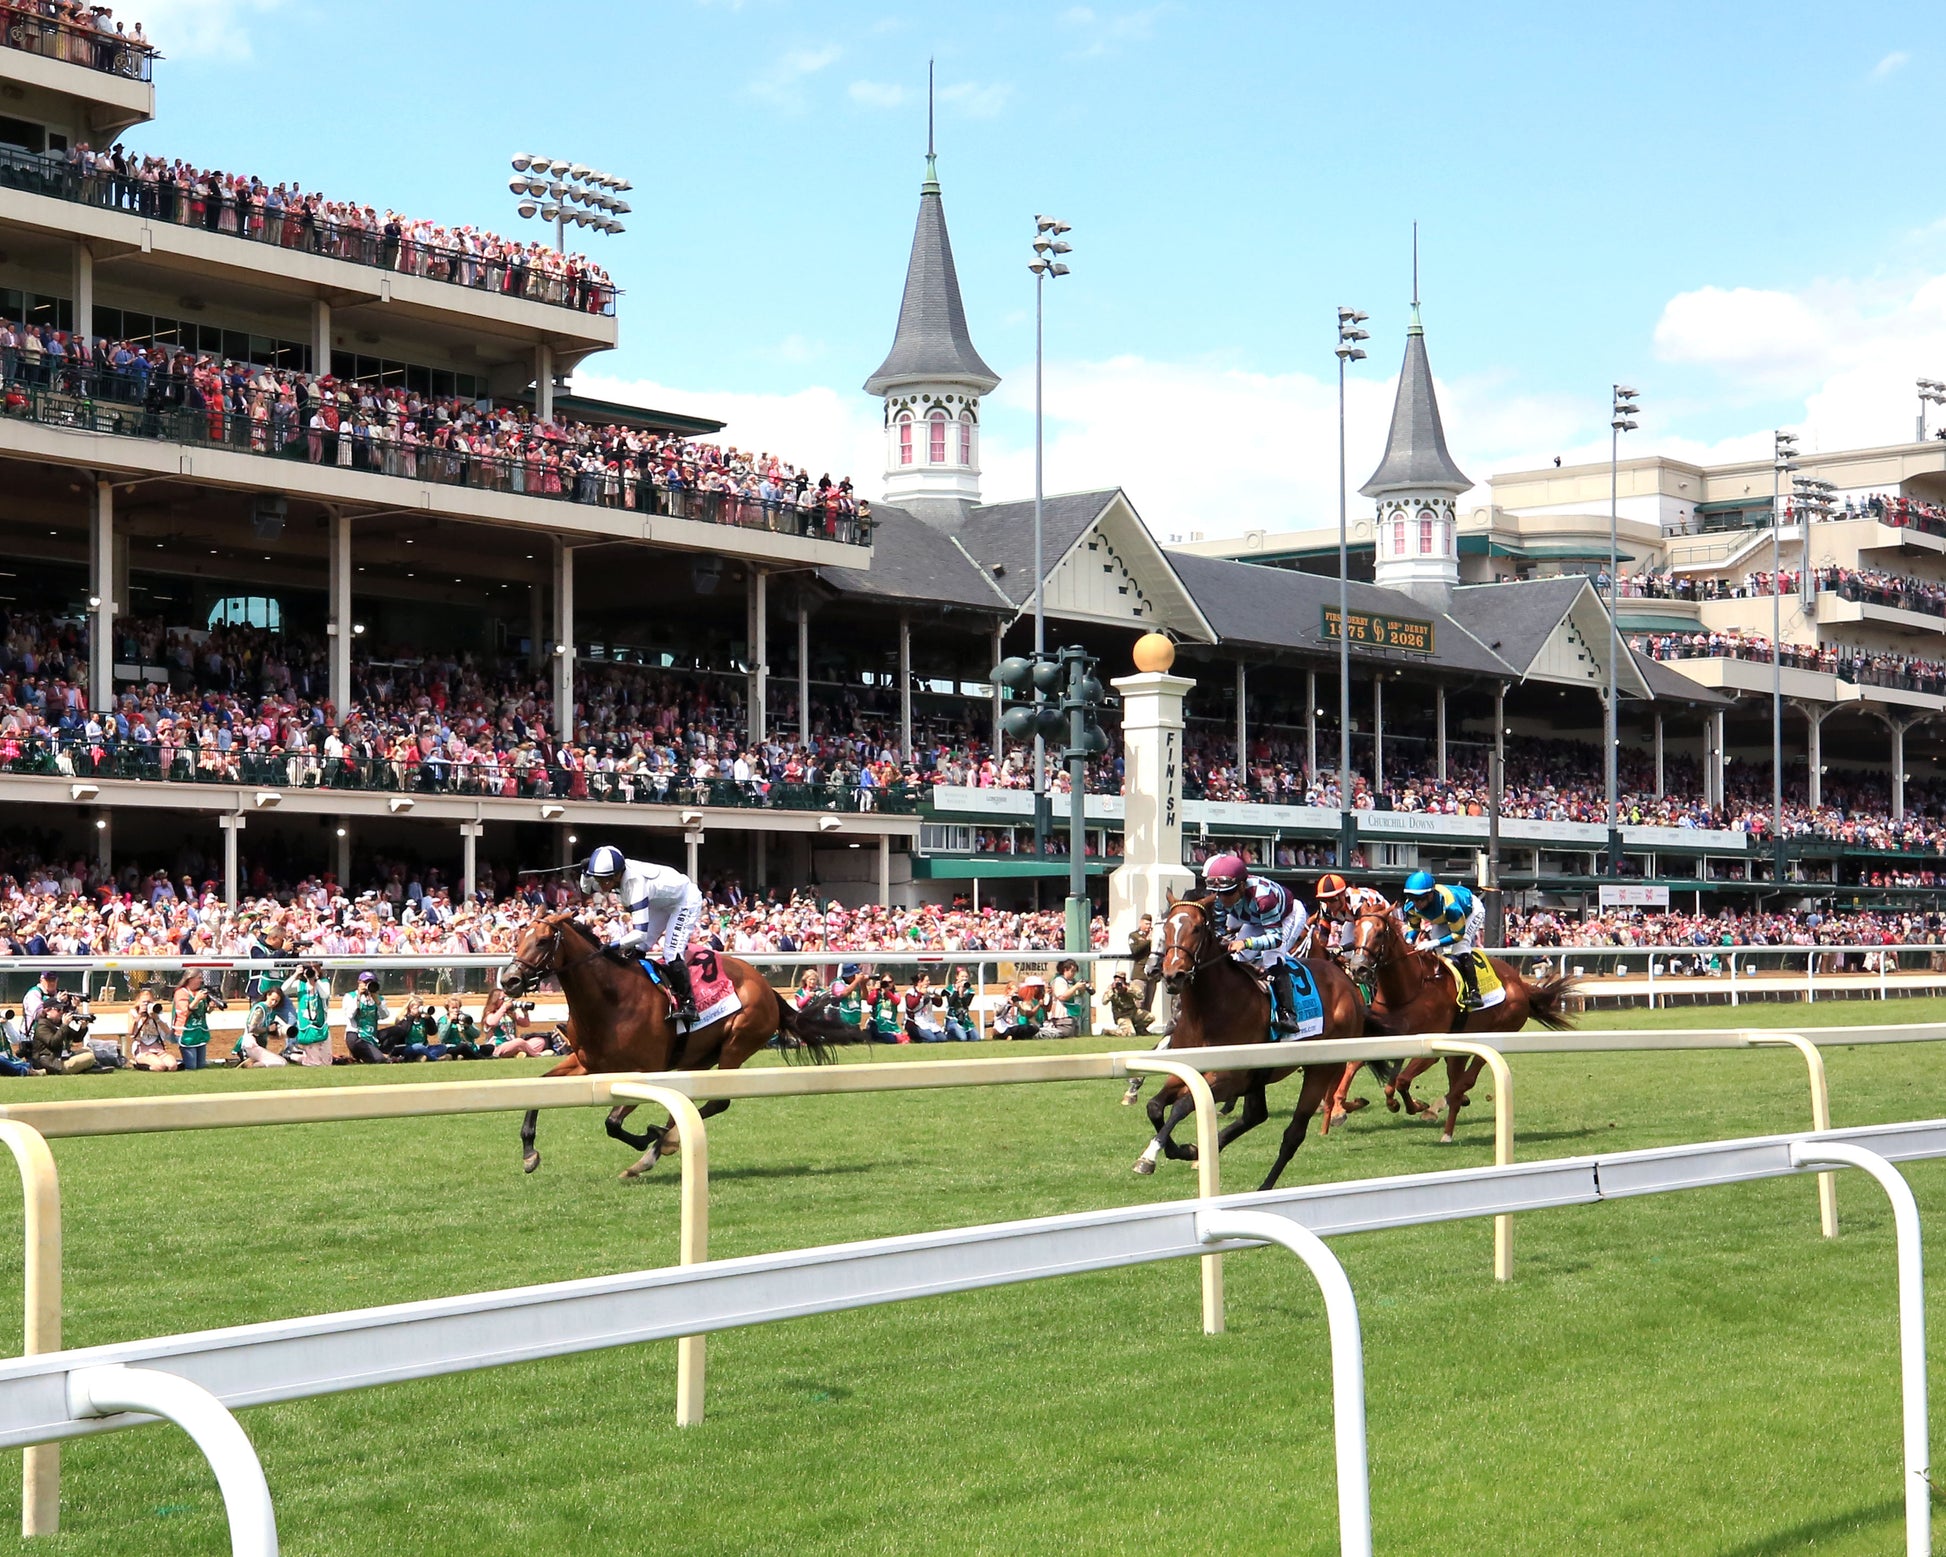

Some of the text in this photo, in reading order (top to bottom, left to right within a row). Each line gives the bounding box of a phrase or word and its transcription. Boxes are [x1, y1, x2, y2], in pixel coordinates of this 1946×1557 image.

[1325, 612, 1341, 623] FIRS
[1404, 624, 1428, 635] DERBY
[1390, 633, 1424, 648] 2026
[1166, 732, 1175, 827] FINISH
